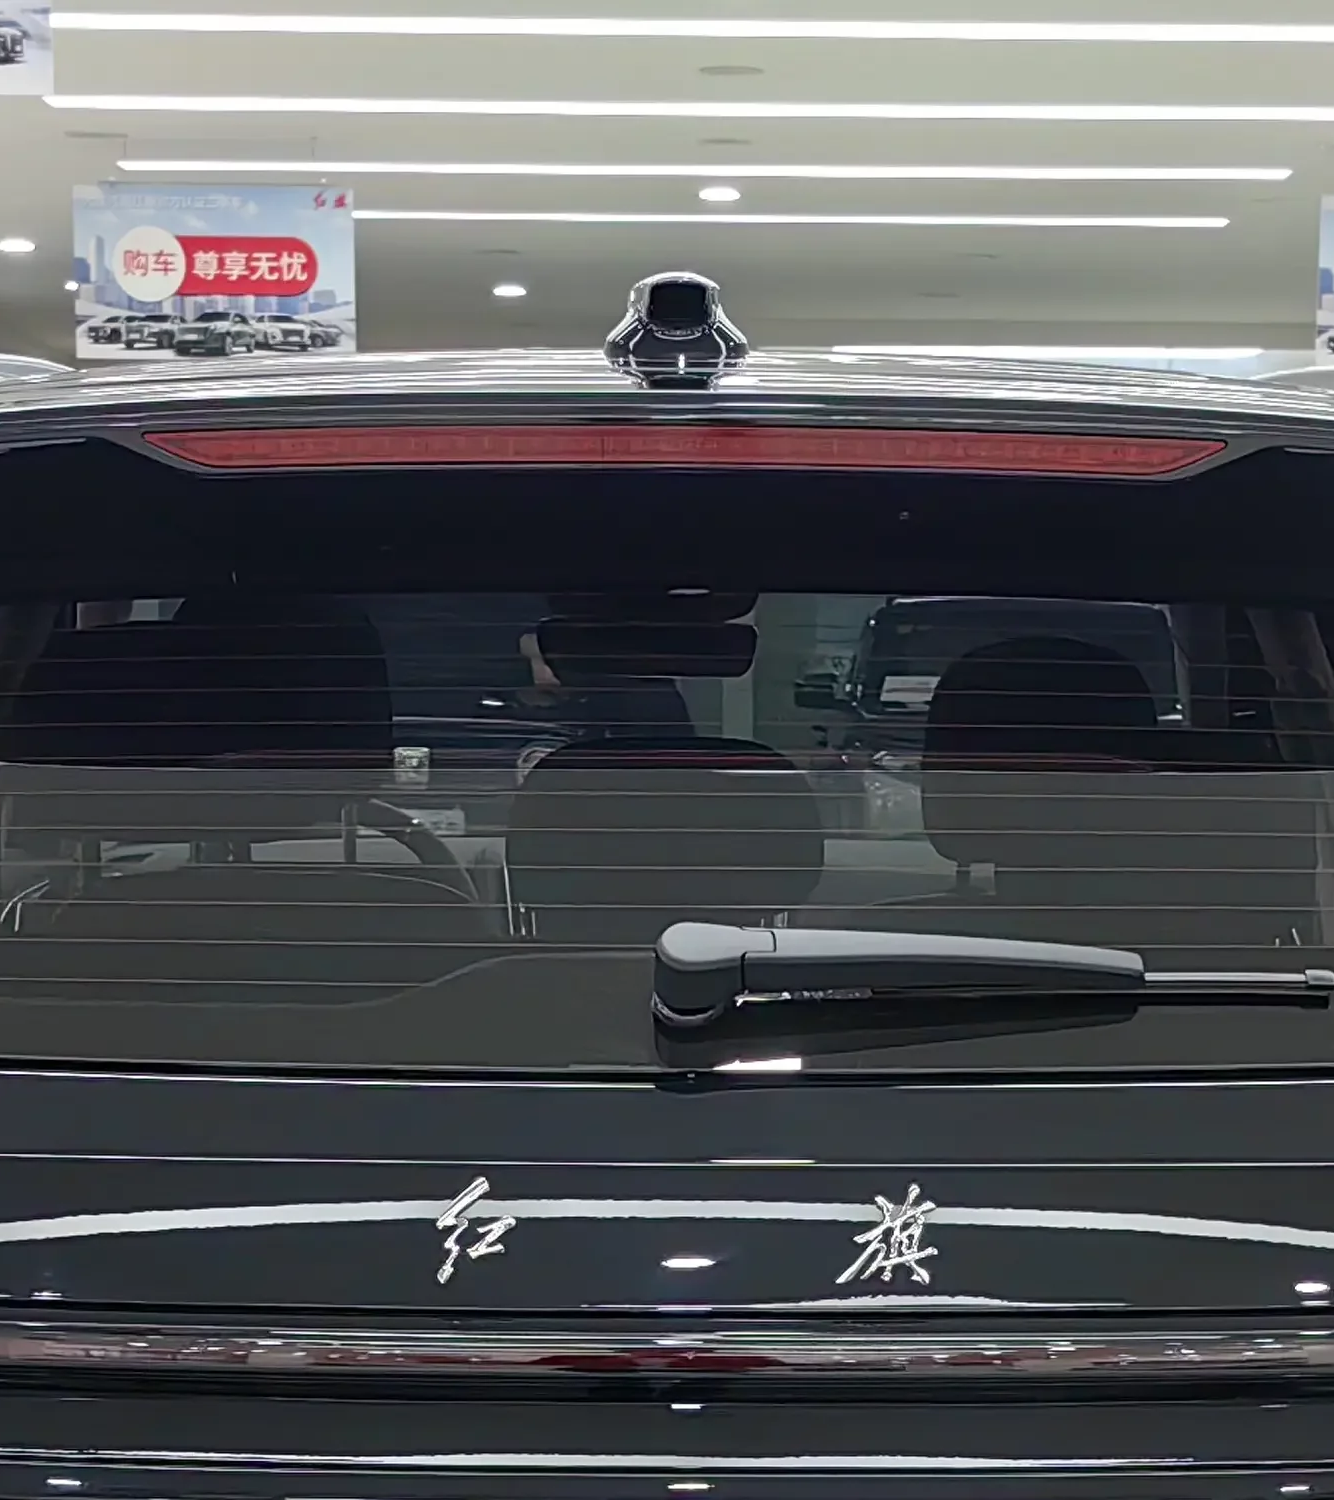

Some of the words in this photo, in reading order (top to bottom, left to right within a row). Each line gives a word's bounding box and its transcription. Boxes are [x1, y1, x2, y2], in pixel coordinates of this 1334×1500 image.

[123, 250, 177, 277] 购车
[192, 250, 308, 281] 尊享无忧
